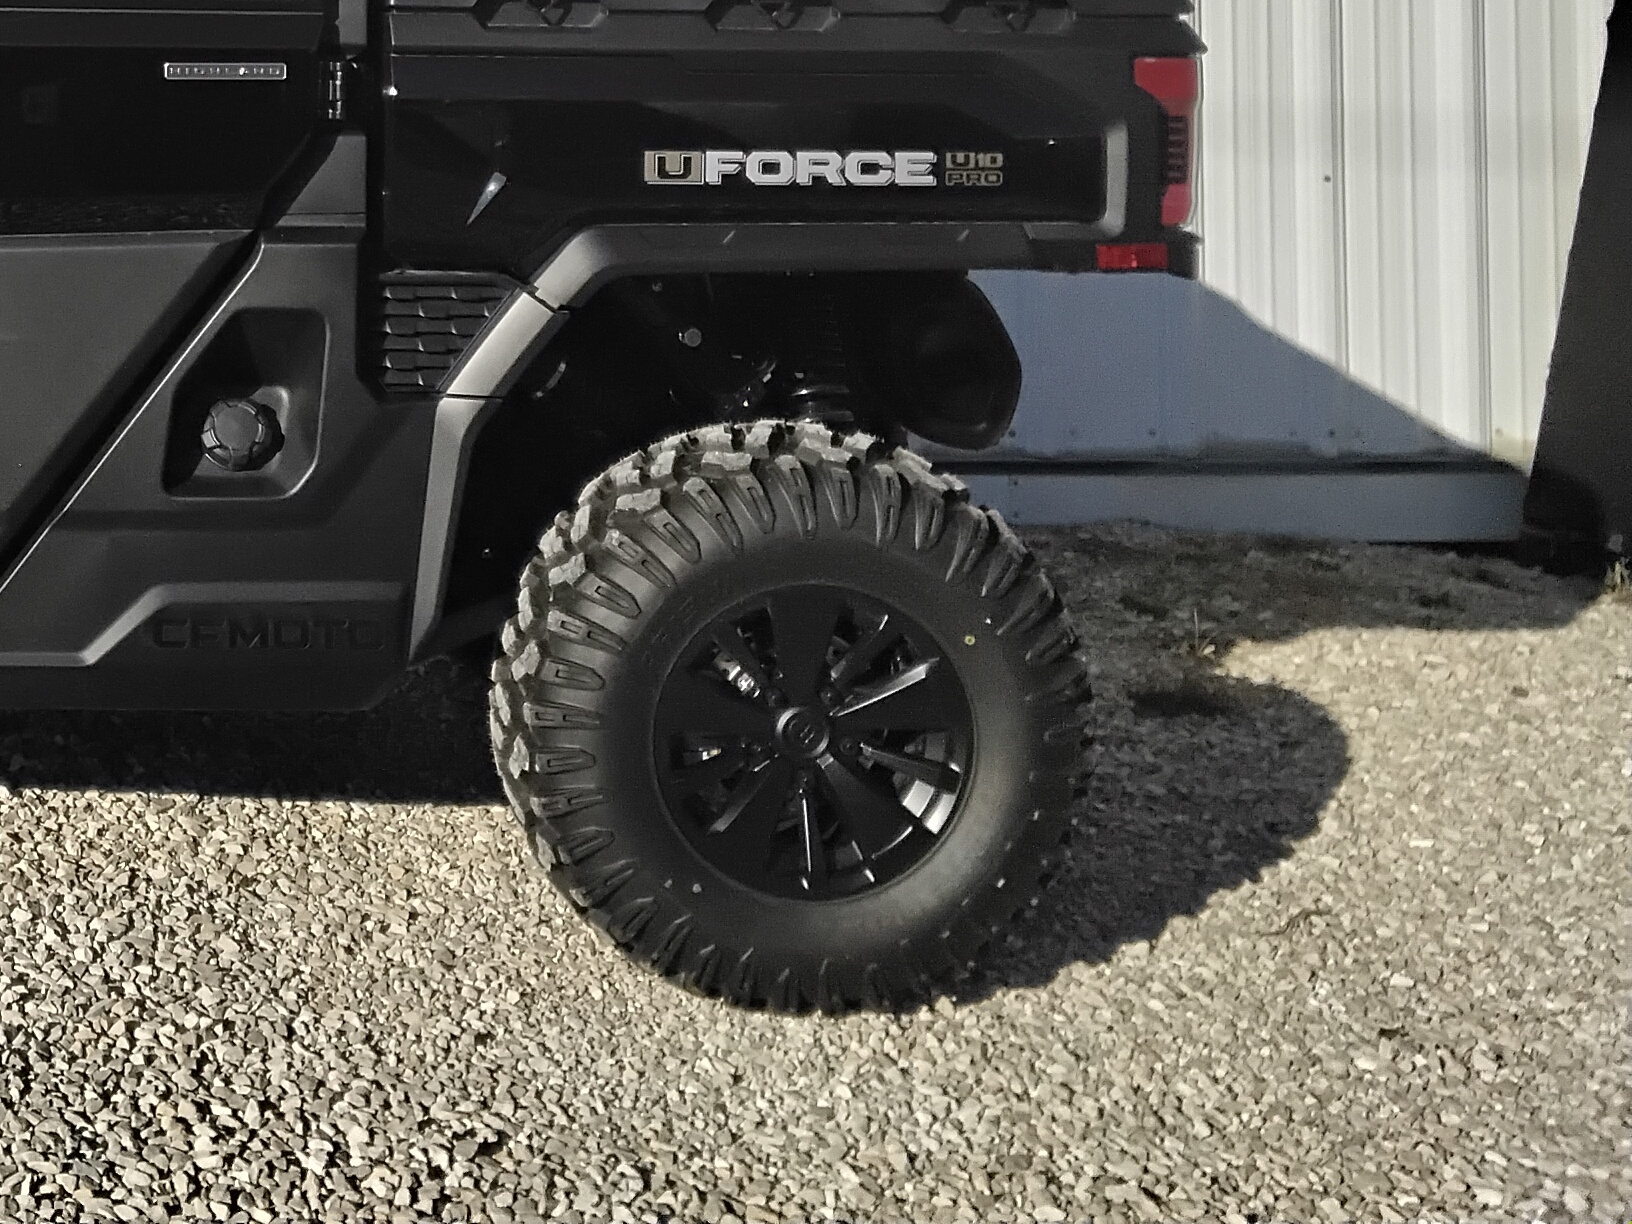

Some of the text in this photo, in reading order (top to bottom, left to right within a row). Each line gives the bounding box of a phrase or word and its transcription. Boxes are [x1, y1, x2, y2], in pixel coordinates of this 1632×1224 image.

[945, 151, 1003, 169] U10
[945, 170, 1003, 186] PRO
[153, 618, 385, 651] CFMOTO
